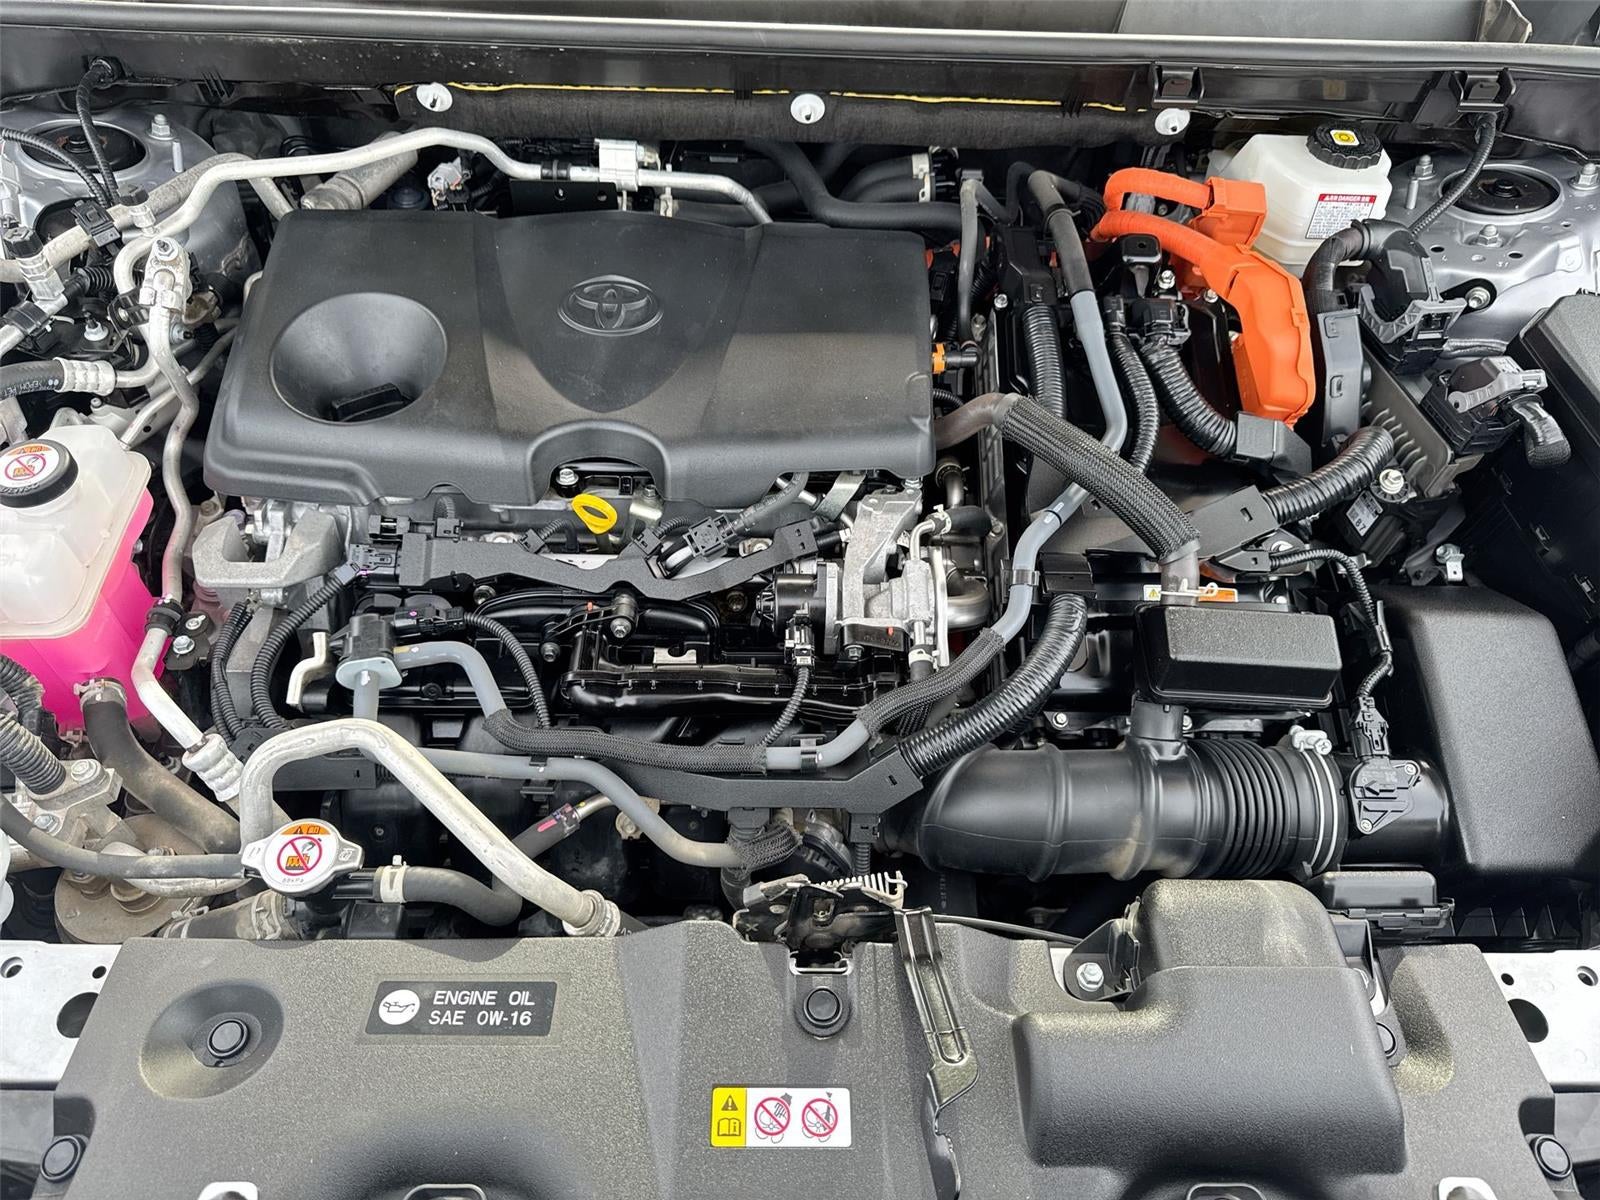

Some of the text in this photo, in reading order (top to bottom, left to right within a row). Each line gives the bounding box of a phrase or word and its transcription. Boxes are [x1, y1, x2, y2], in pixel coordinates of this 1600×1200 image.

[432, 990, 536, 1006] ENGINE OIL
[428, 1010, 533, 1026] SAE 0W-16
